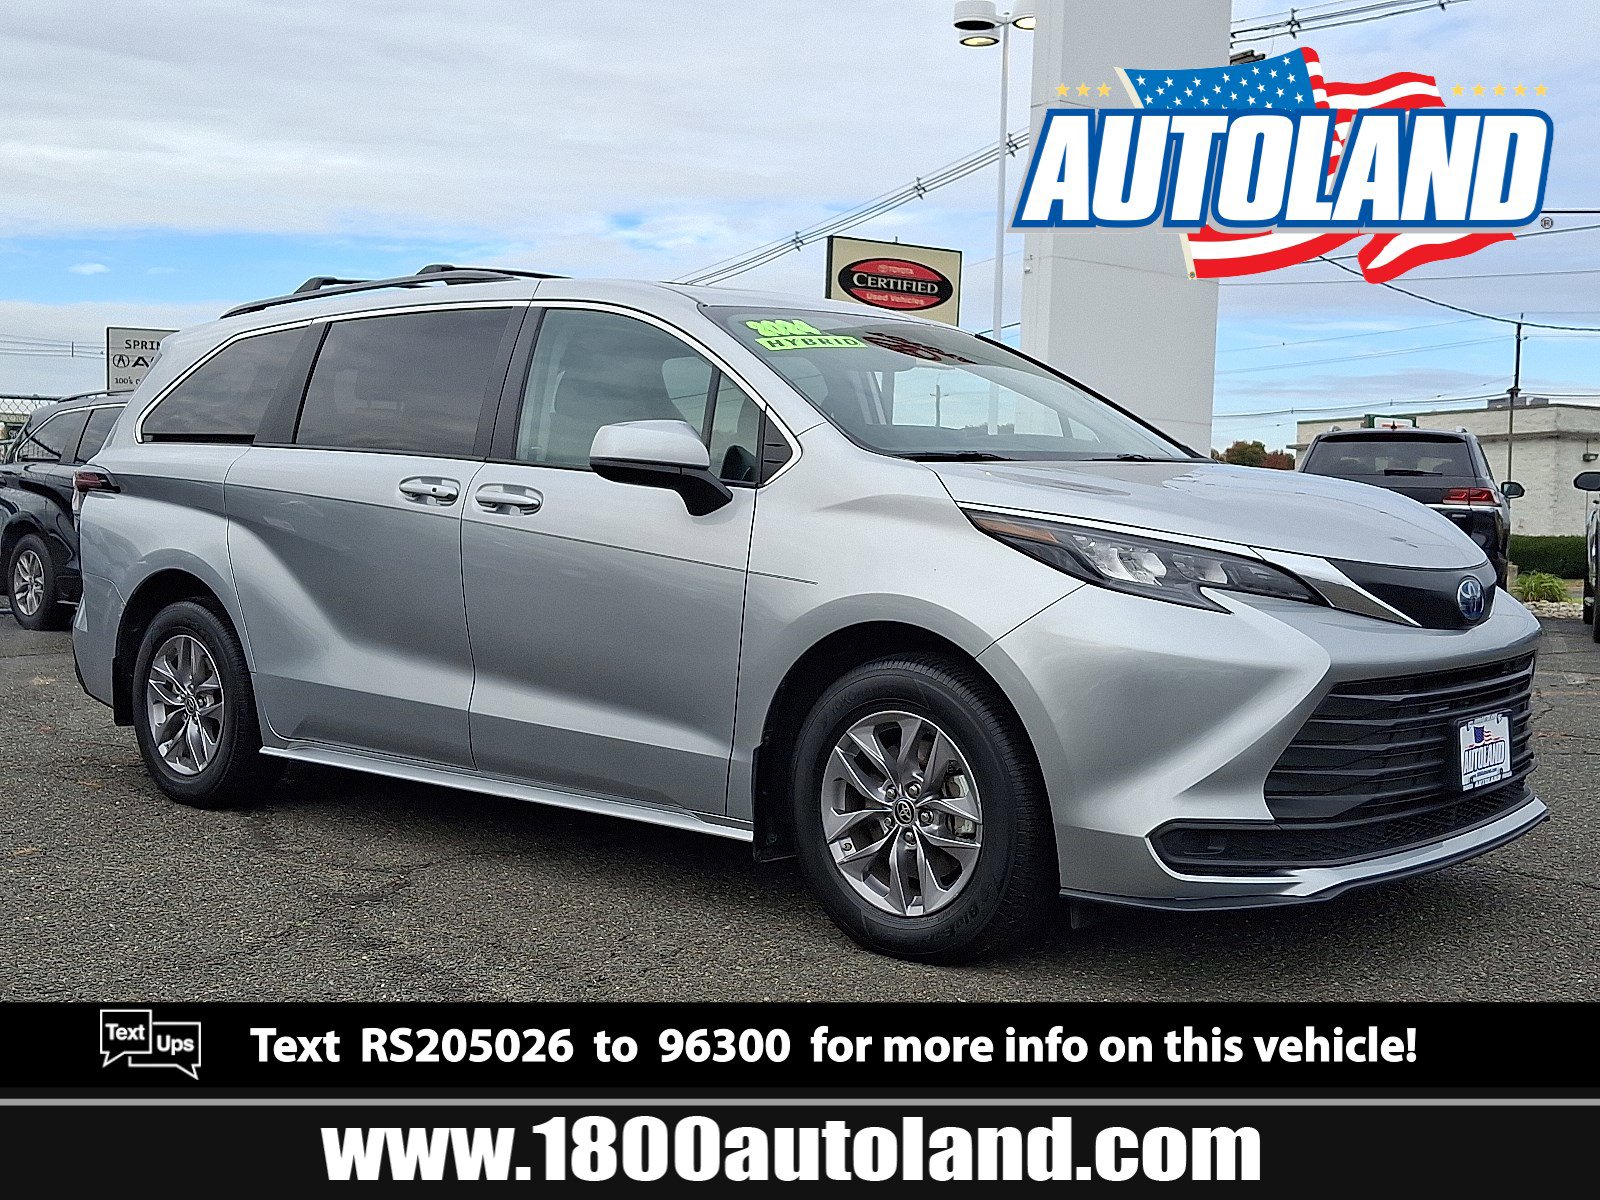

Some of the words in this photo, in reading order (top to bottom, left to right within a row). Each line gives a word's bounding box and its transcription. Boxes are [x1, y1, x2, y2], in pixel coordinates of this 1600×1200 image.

[853, 272, 938, 294] CERTIFIED
[766, 338, 858, 348] HYBRID
[1463, 741, 1505, 775] AUTOLAND
